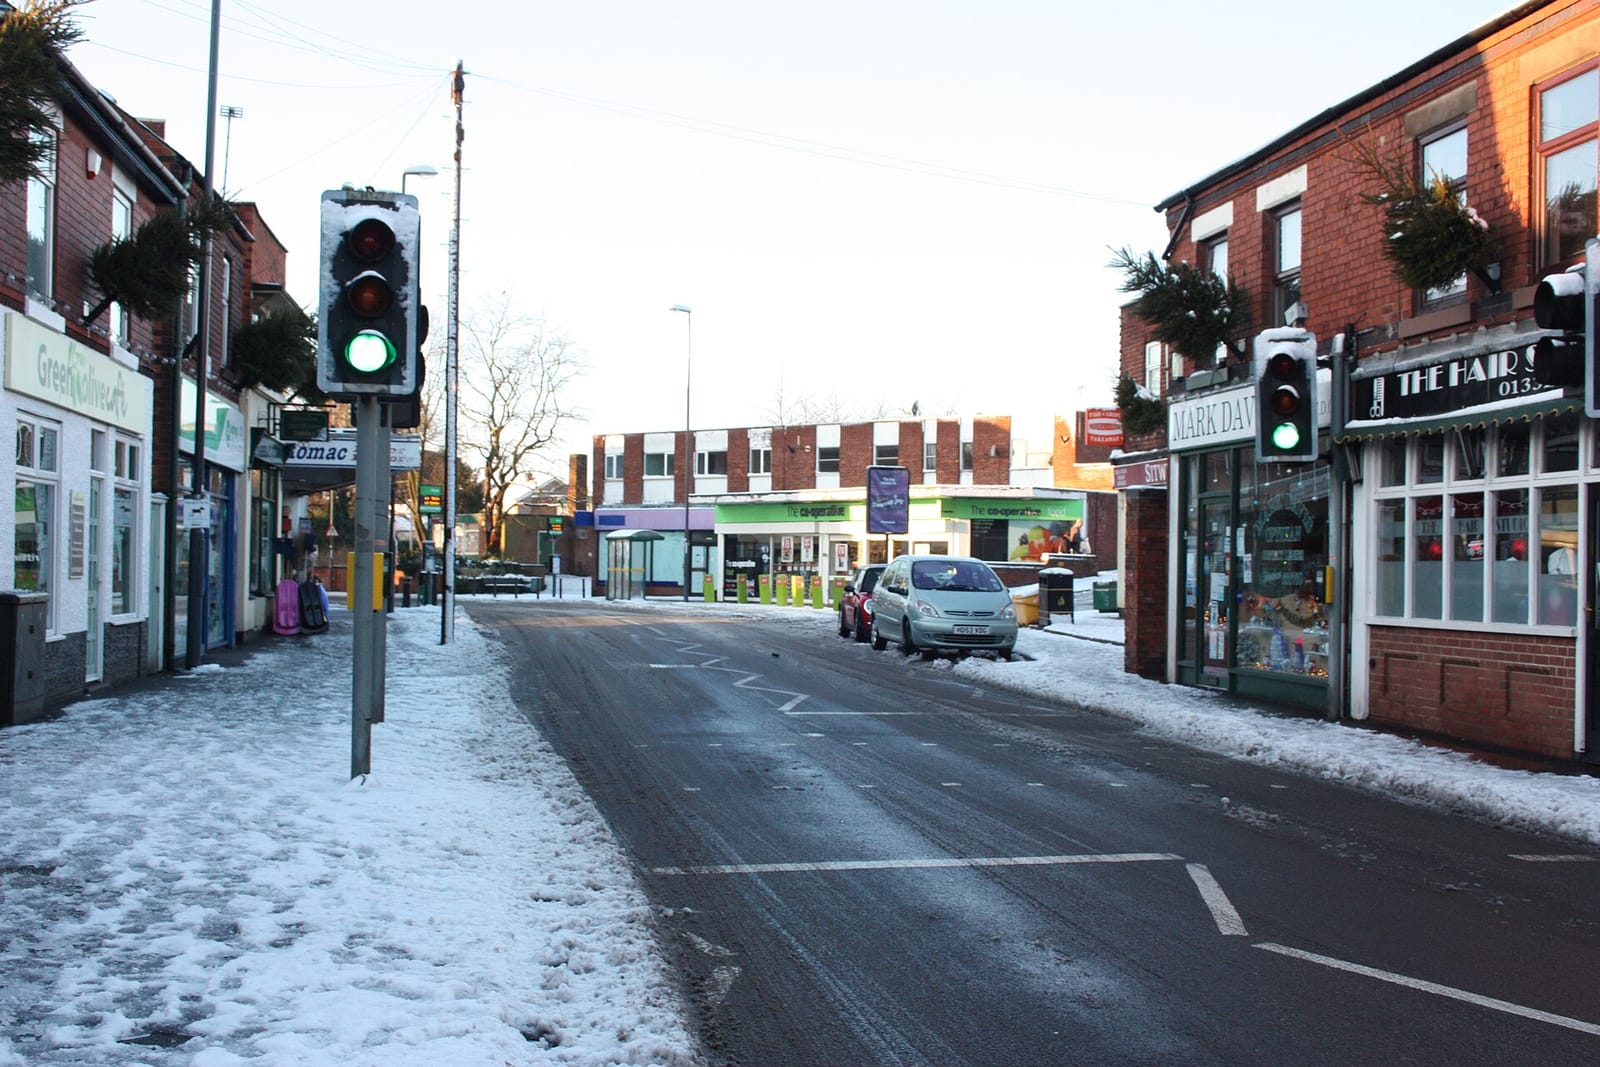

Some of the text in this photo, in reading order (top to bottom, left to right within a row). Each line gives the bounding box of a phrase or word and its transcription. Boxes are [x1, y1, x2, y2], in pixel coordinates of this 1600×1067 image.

[37, 342, 72, 399] Green
[1397, 364, 1443, 397] THE
[1449, 350, 1517, 388] HAIR
[1173, 395, 1256, 442] MARK DAV
[1144, 462, 1168, 483] SITW
[800, 504, 845, 519] co-operative
[970, 504, 986, 515] The
[987, 505, 1041, 518] co-operative
